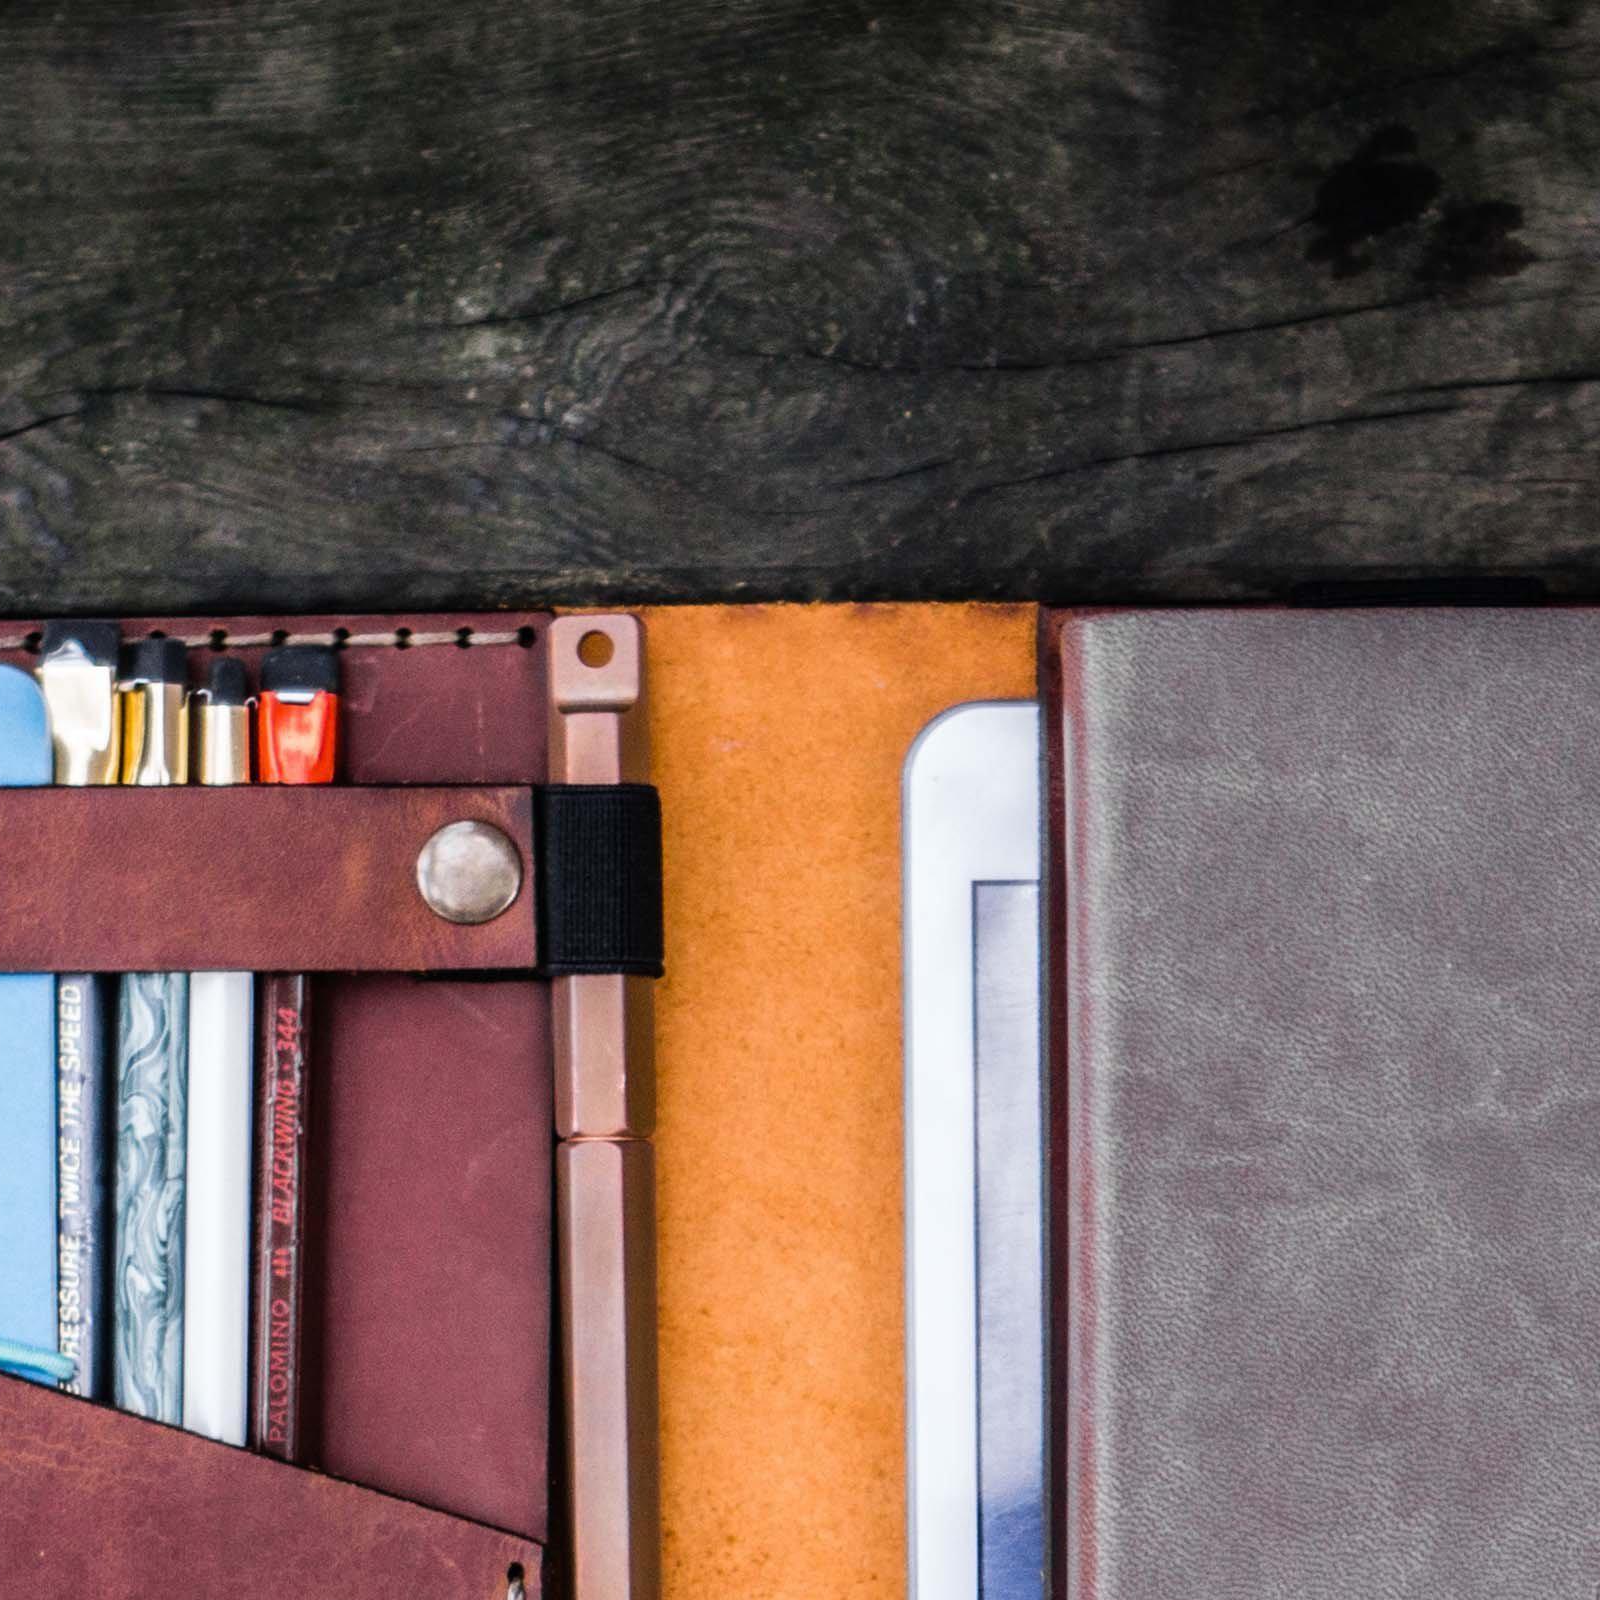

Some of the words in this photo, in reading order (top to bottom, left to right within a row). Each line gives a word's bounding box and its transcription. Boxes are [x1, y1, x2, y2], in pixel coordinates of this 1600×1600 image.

[60, 984, 82, 1071] SPEED
[277, 1007, 298, 1051] 344
[60, 1080, 82, 1129] THE
[59, 1136, 81, 1218] TWICE
[272, 1079, 297, 1224] BLACKWING
[59, 1230, 82, 1372] RESSURE,
[269, 1299, 289, 1441] PALOMINO
